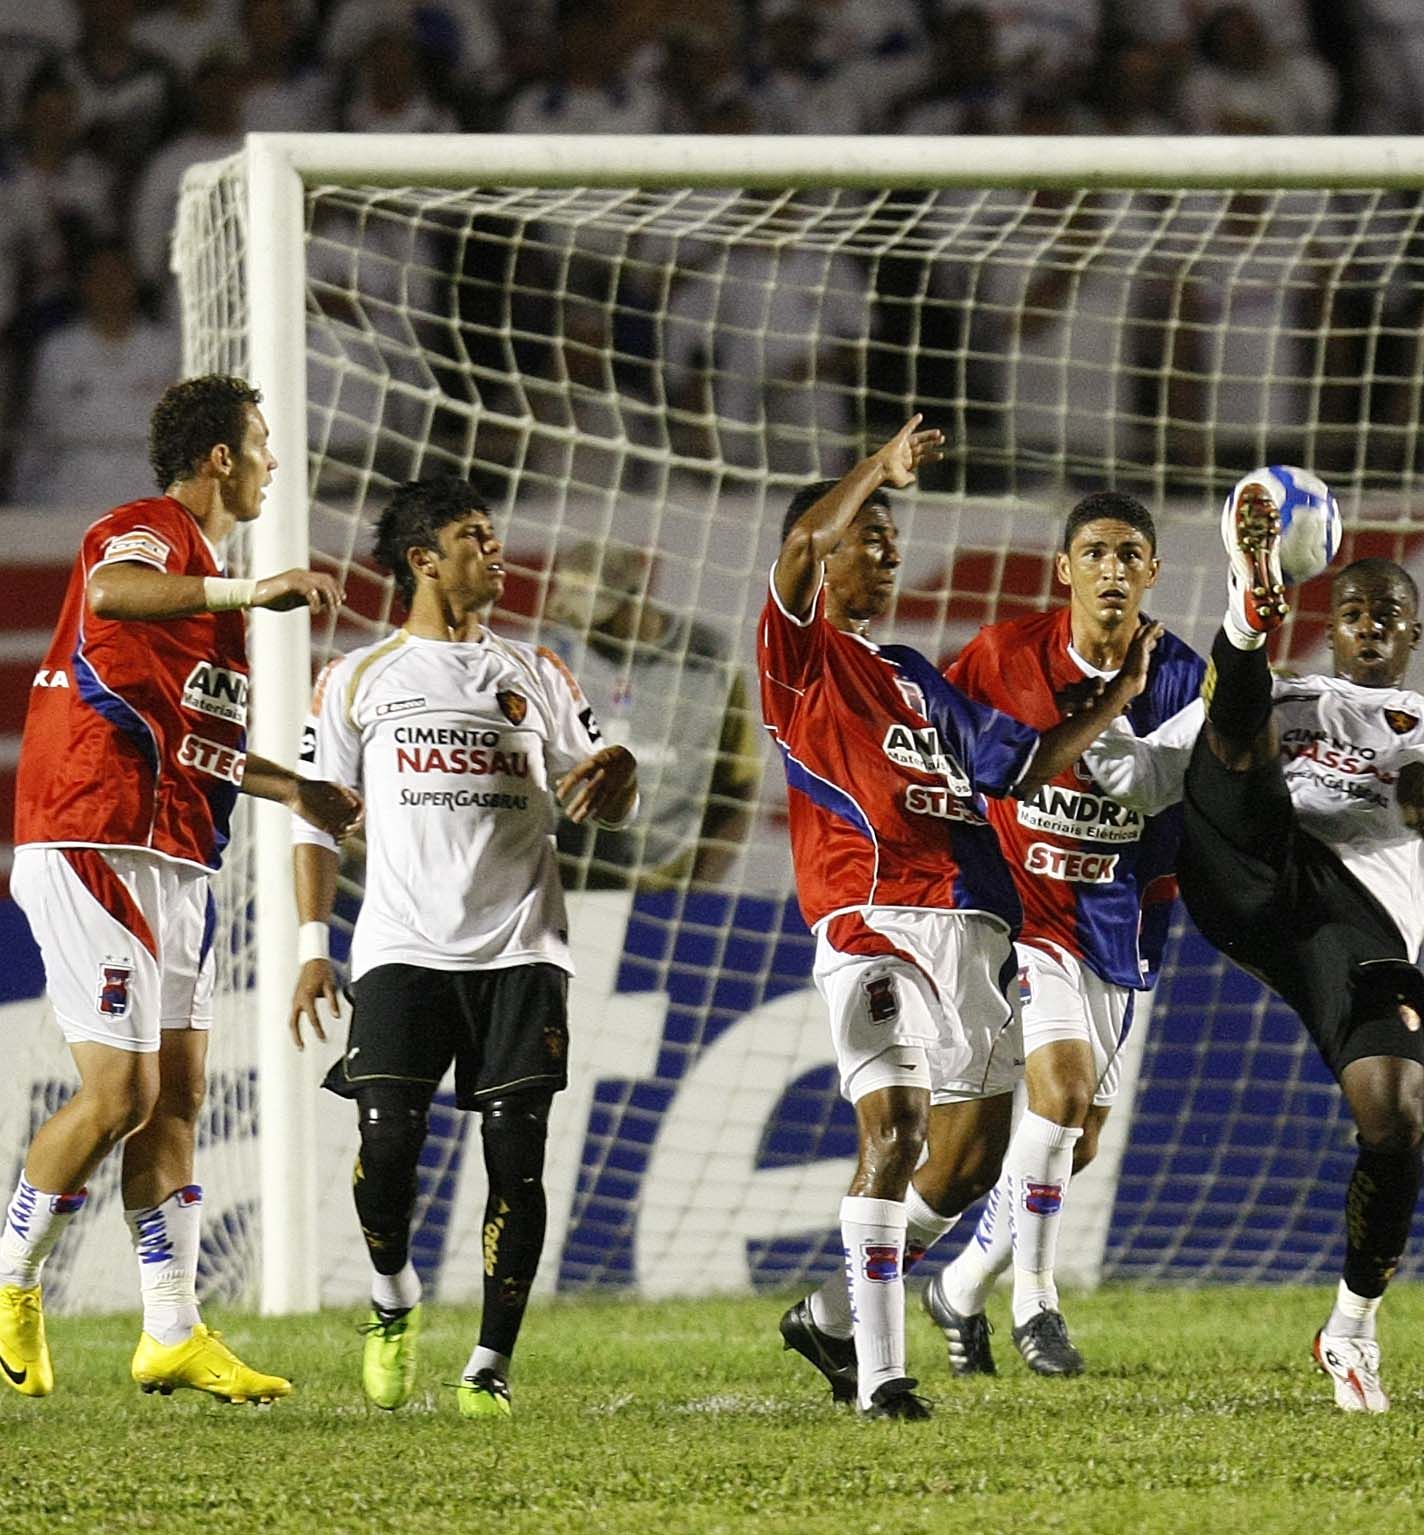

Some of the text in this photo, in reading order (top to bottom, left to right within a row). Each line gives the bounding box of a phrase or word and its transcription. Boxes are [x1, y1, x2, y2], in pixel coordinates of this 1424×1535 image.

[395, 728, 499, 747] CIMENTO
[396, 748, 528, 777] NASSAU
[1021, 810, 1082, 836] Materiais
[1023, 792, 1140, 828] ANDRA
[1029, 847, 1116, 880] STECK
